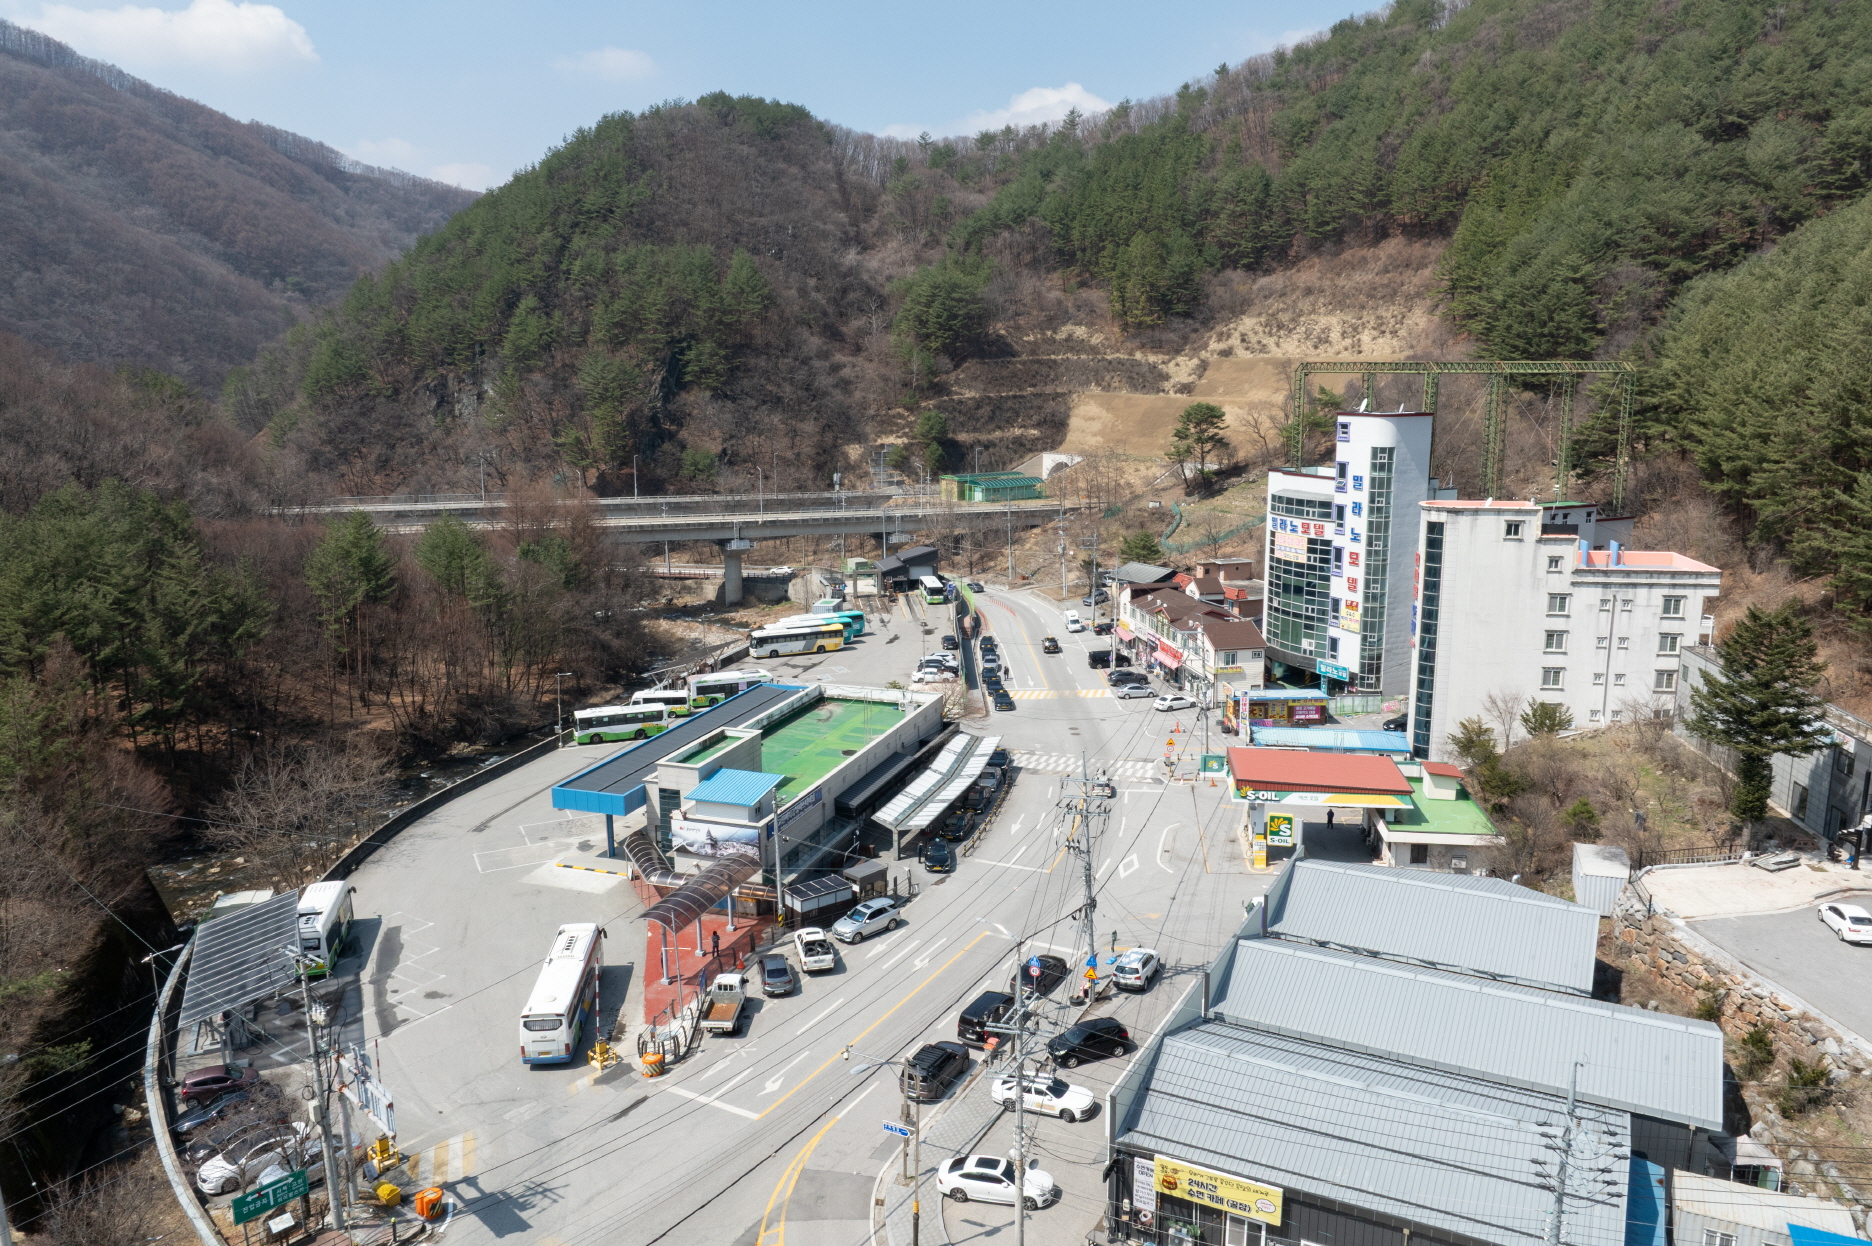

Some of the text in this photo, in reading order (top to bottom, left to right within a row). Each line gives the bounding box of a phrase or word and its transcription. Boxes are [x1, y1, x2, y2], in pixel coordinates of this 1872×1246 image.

[1246, 790, 1280, 800] S-OIL
[1279, 824, 1291, 836] S
[1188, 1178, 1218, 1192] 24시간
[1188, 1188, 1205, 1200] 수면
[1207, 1193, 1224, 1206] 카페
